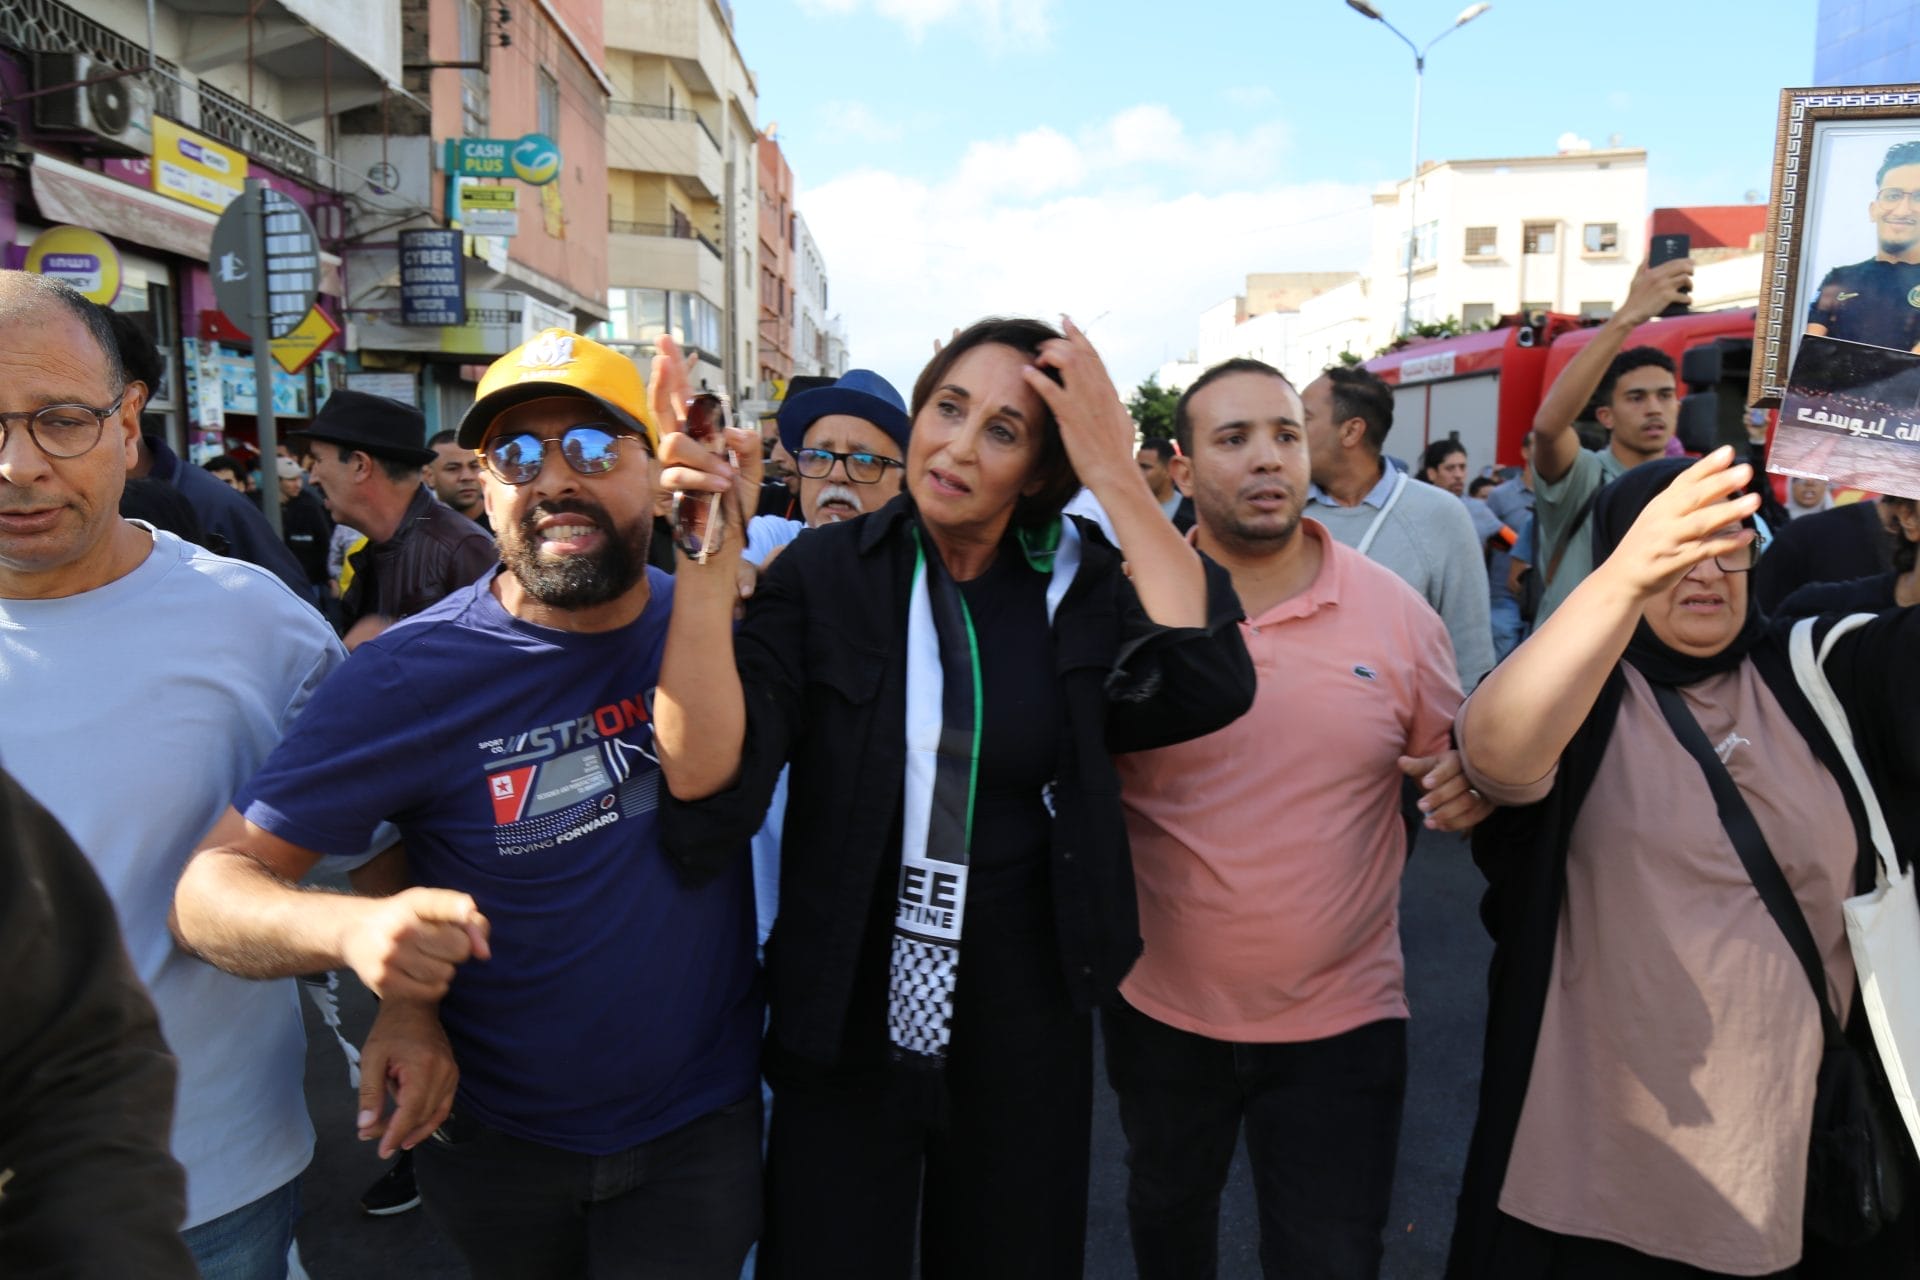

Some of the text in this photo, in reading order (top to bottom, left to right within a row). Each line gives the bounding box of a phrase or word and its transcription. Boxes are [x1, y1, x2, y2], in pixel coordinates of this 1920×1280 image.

[465, 143, 505, 158] CASH
[465, 158, 504, 172] PLUS
[404, 250, 455, 266] CYBER
[478, 738, 504, 749] SPORT
[498, 811, 619, 856] MOVING FORWARD
